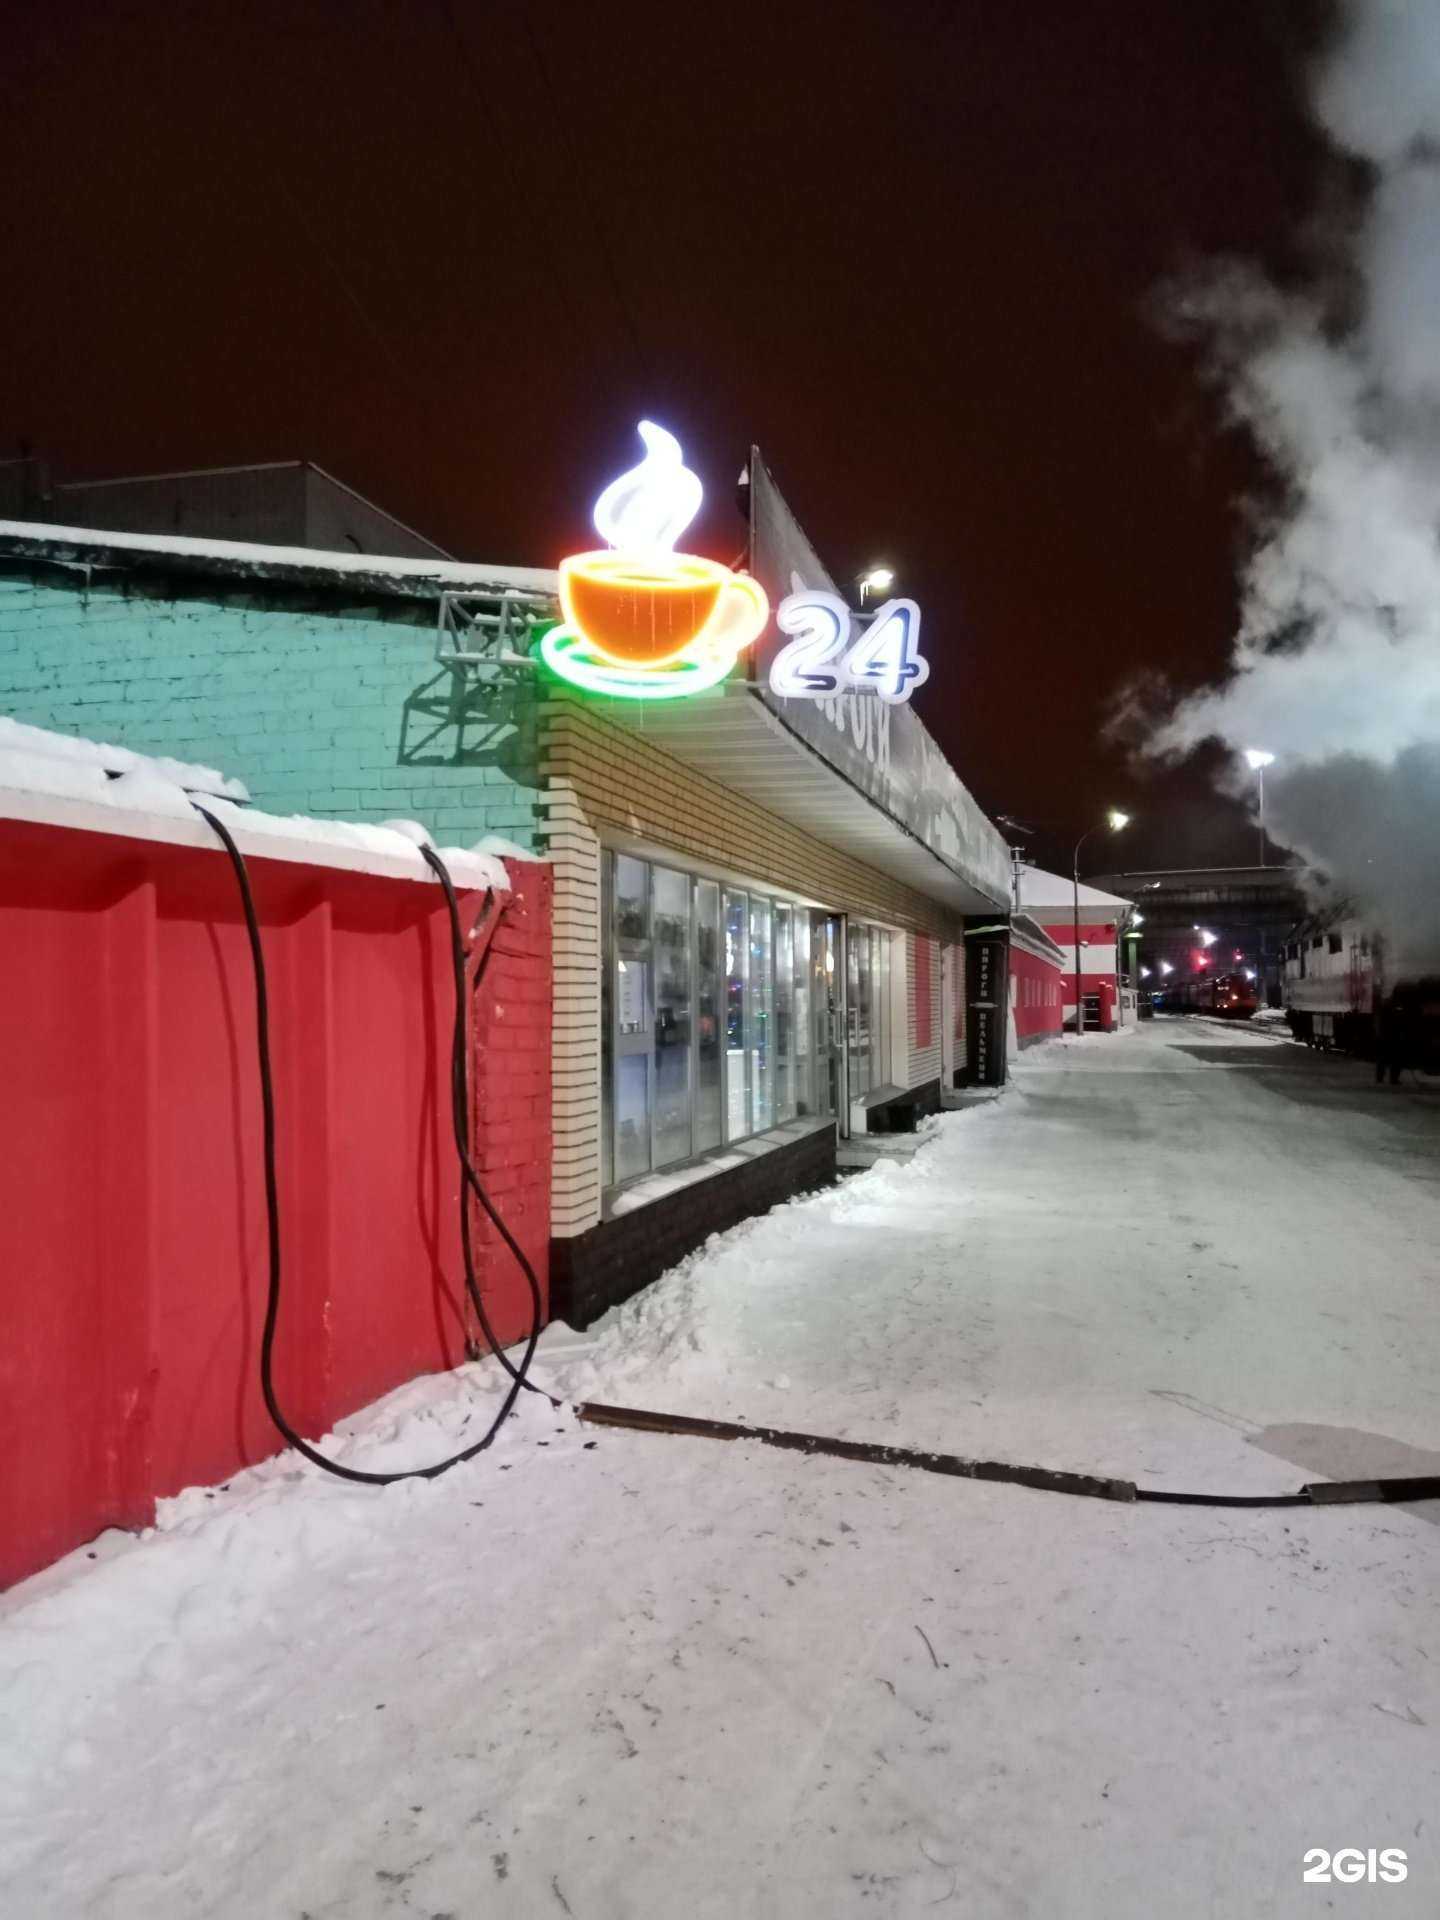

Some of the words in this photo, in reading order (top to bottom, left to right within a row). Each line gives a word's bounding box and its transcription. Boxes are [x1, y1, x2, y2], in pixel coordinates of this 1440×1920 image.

[770, 590, 929, 704] 24
[980, 947, 989, 997] ПИРОГИ
[978, 1013, 987, 1080] ПЕЛЬМЕНИ
